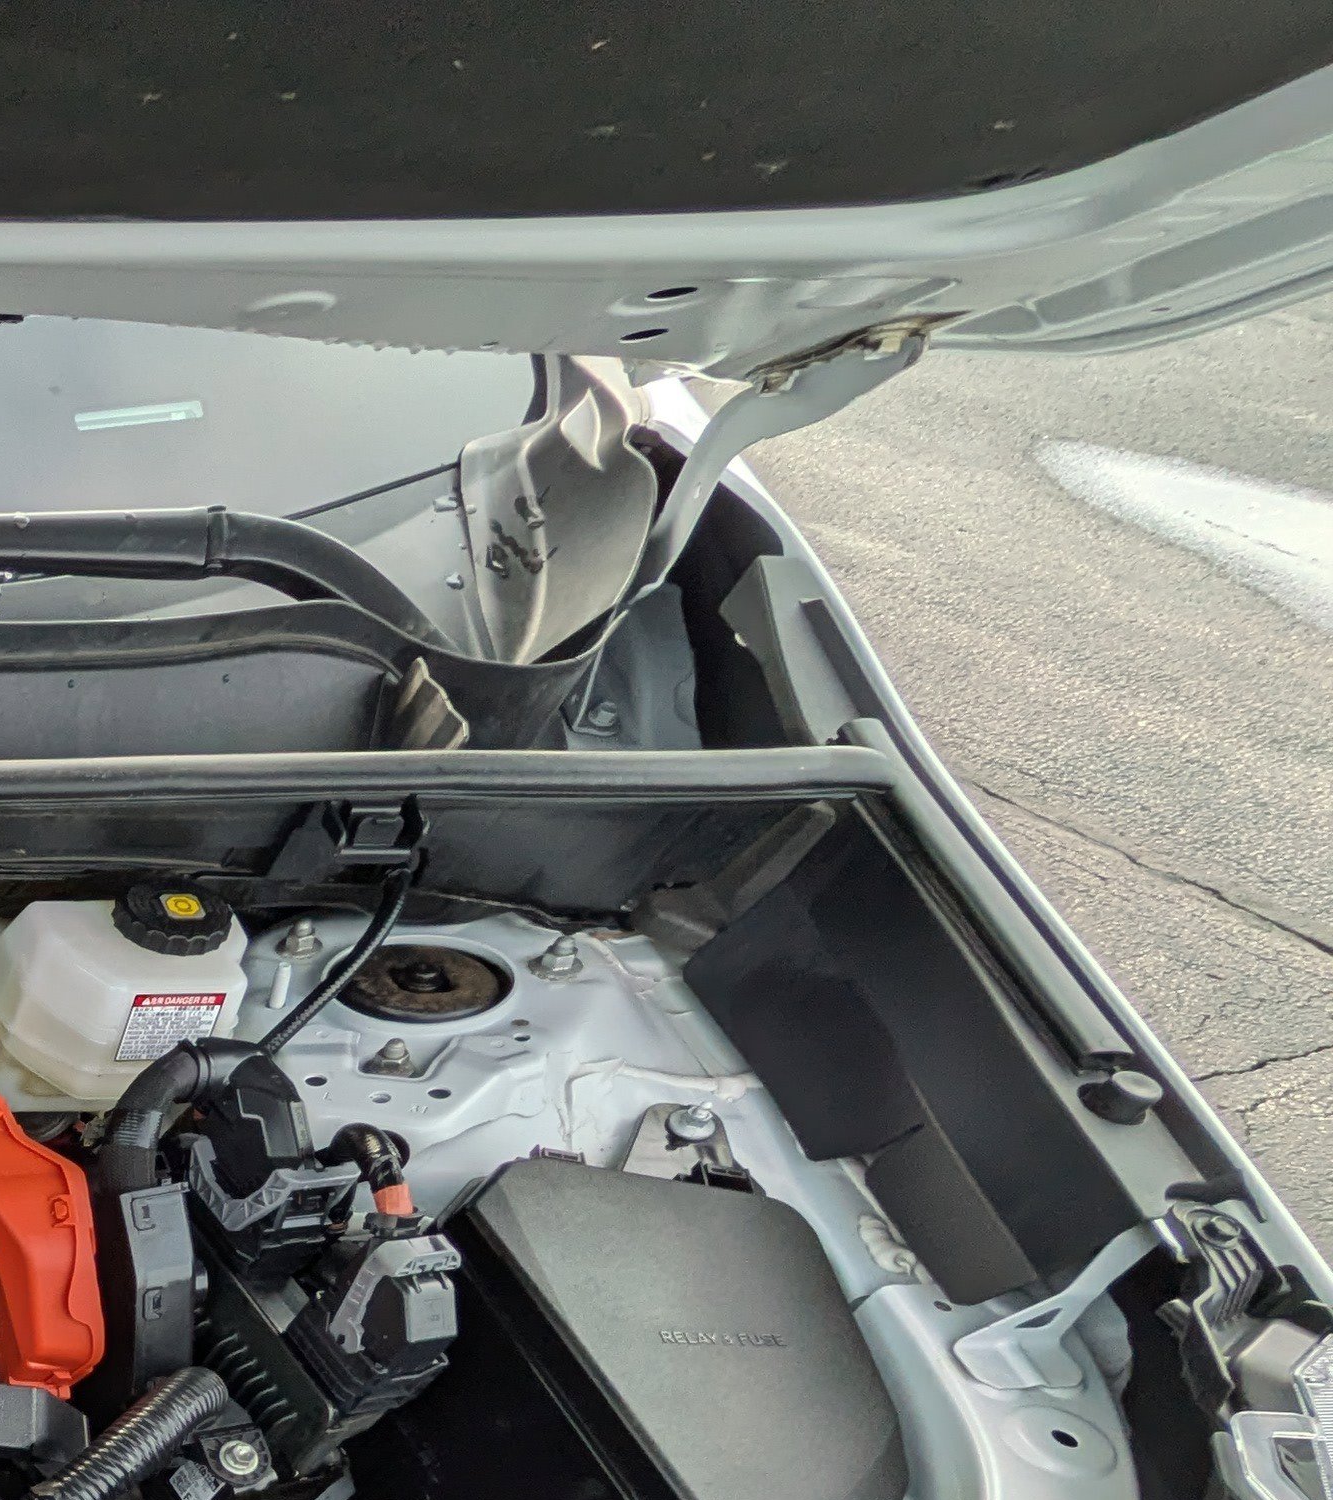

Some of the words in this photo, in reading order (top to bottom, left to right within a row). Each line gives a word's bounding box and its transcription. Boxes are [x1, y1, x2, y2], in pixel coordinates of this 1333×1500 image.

[163, 995, 201, 1005] DANGER
[658, 1329, 717, 1345] RELAY
[736, 1332, 788, 1347] FUSE
